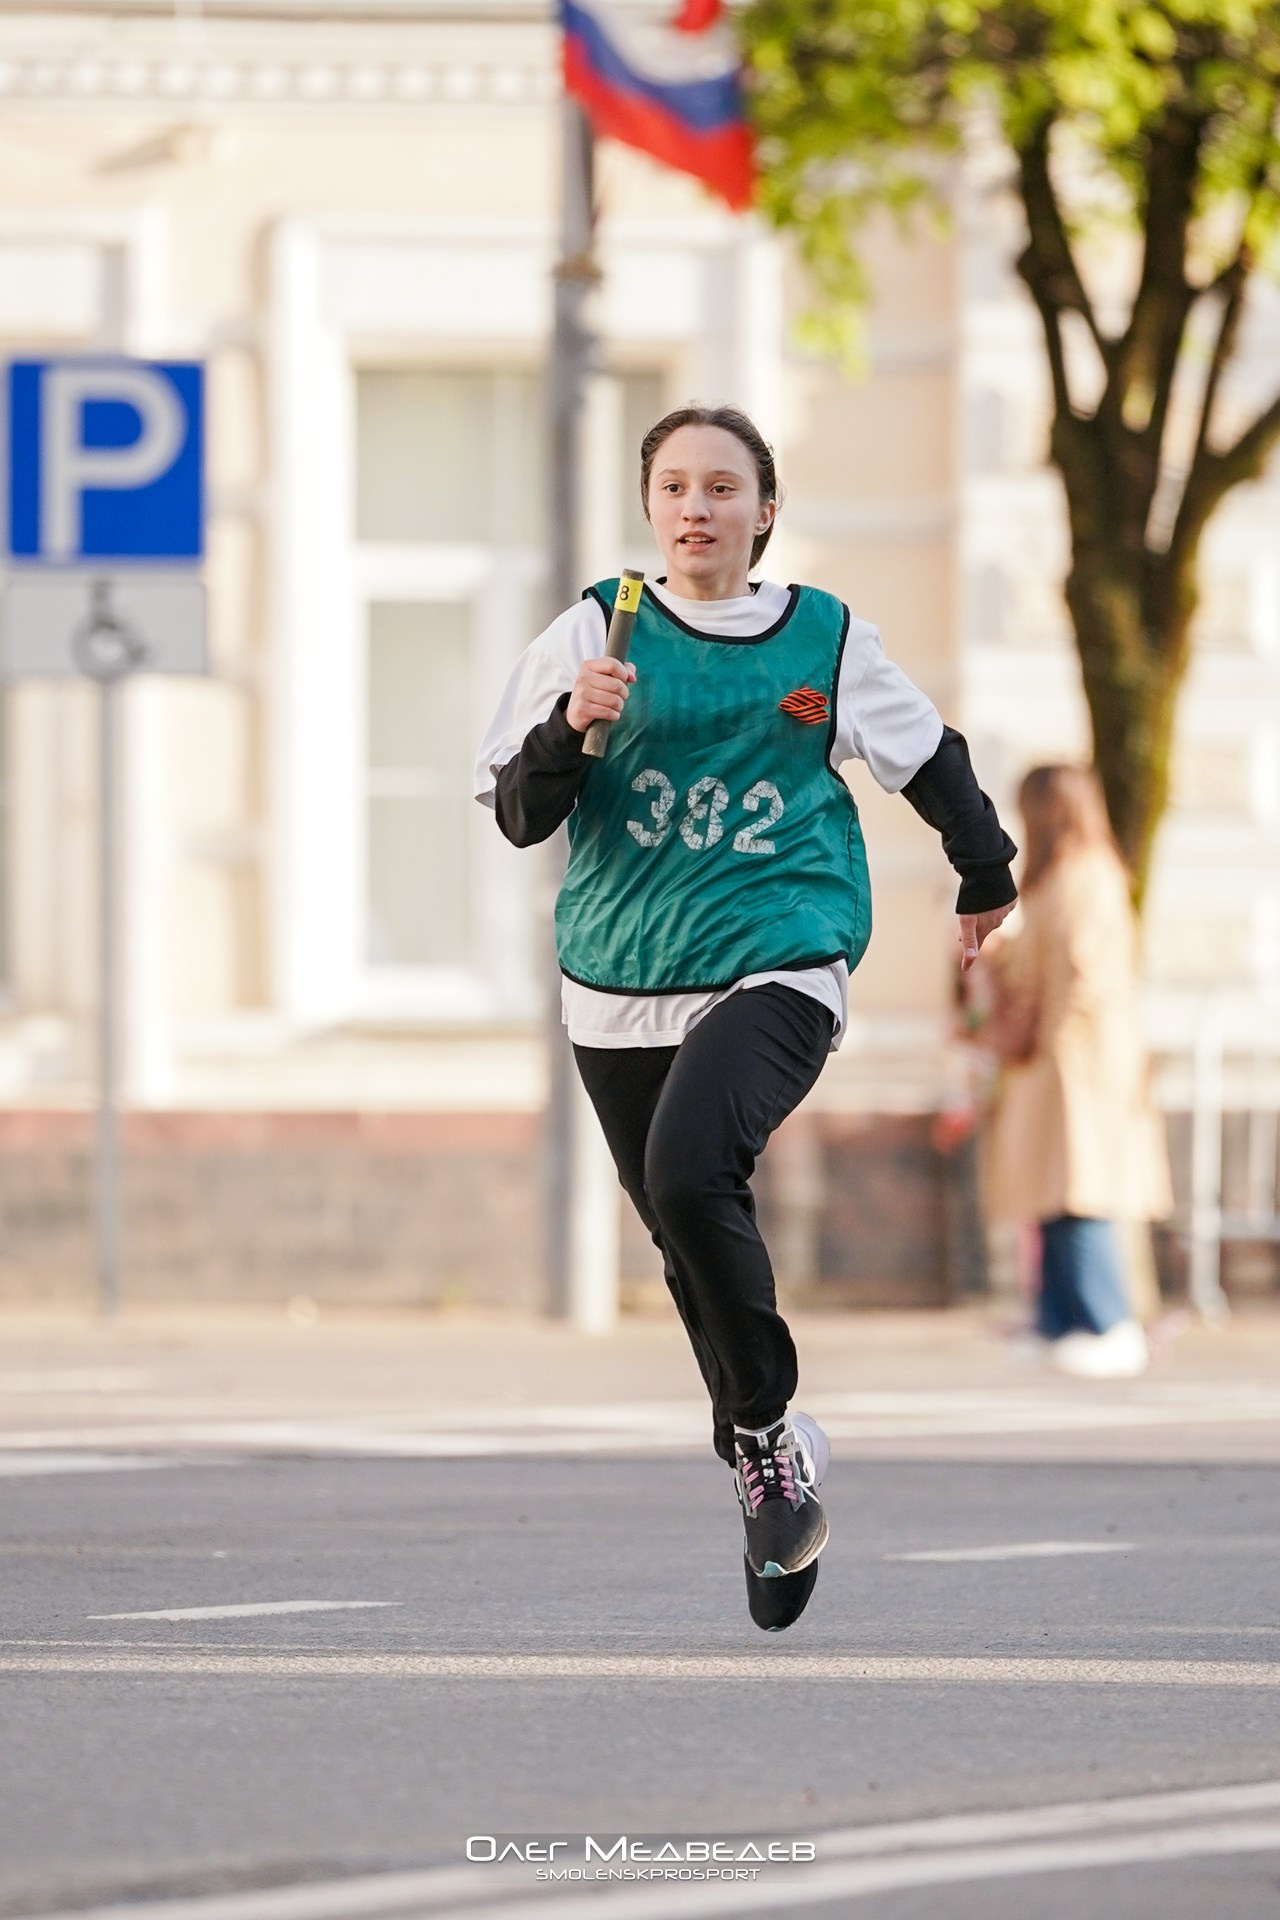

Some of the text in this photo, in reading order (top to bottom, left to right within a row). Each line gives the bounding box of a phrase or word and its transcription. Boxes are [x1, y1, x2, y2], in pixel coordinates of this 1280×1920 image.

[40, 366, 188, 558] P
[619, 585, 629, 601] 8
[627, 768, 784, 854] 382
